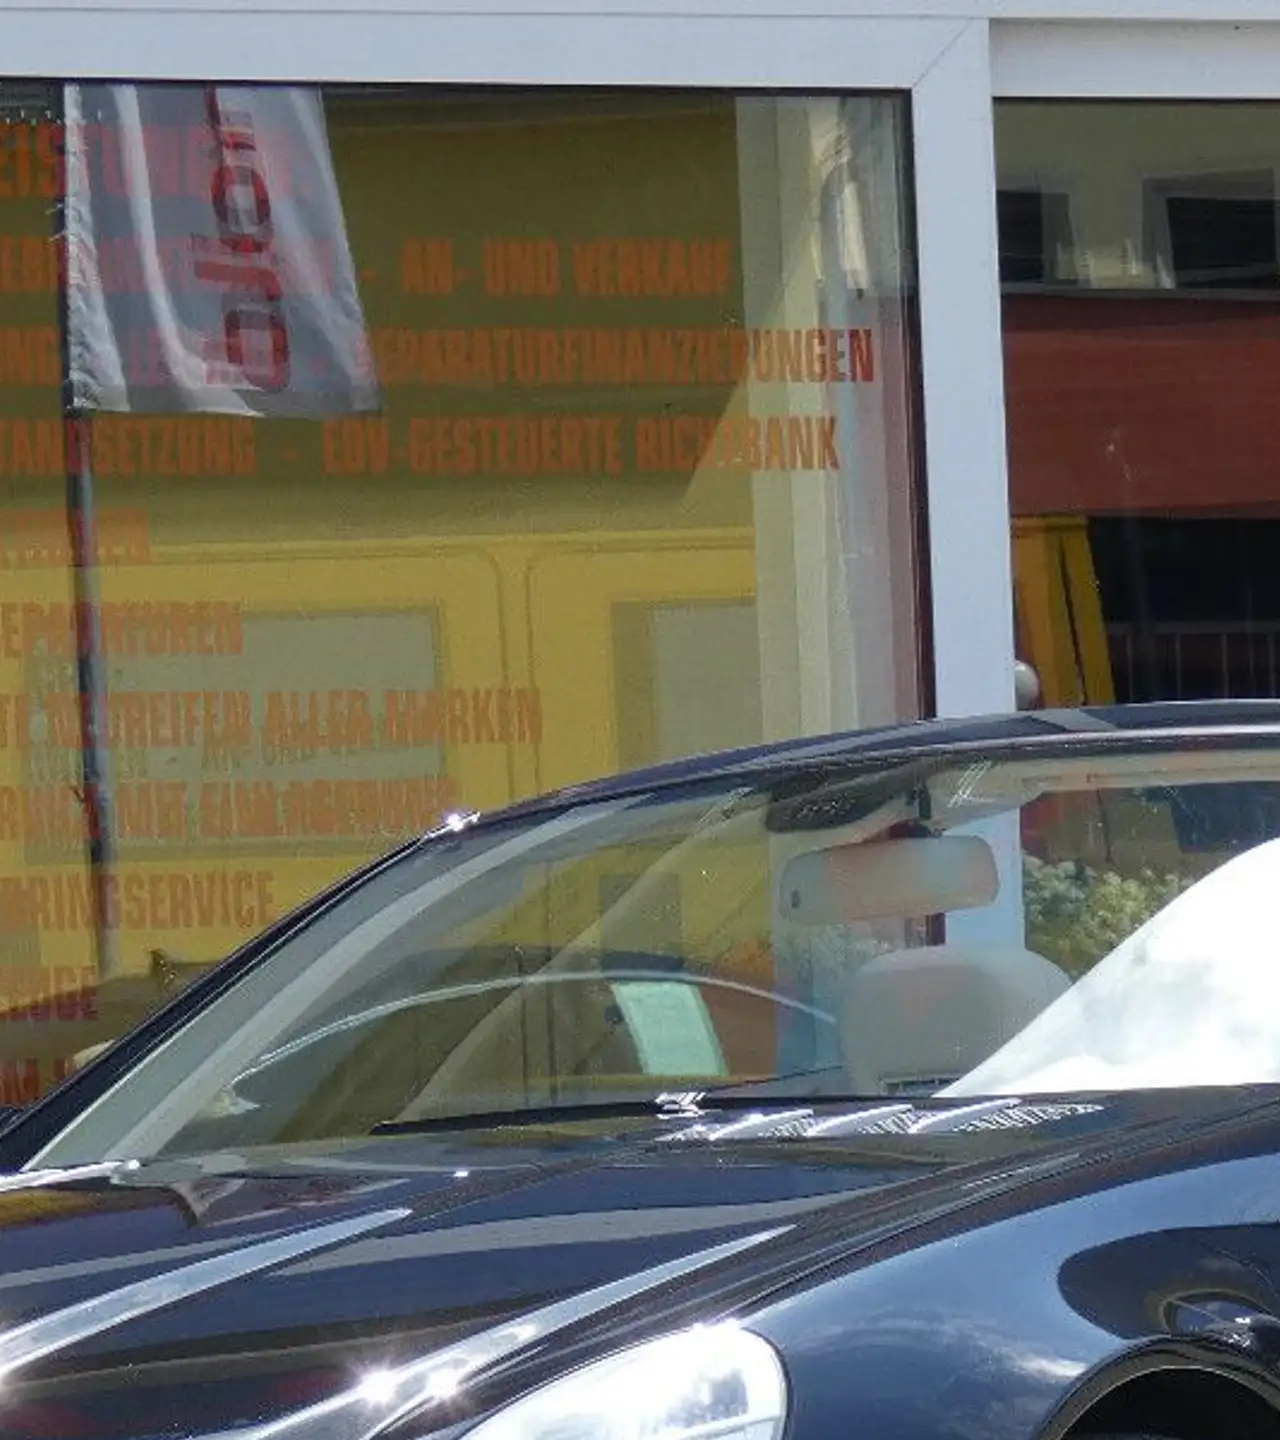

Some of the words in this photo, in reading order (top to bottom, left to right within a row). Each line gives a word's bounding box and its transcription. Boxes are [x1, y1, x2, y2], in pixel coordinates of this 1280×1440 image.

[483, 239, 559, 295] UND
[574, 239, 734, 294] VERKAUF
[264, 689, 373, 746] ALLER
[386, 688, 542, 747] MARKEN
